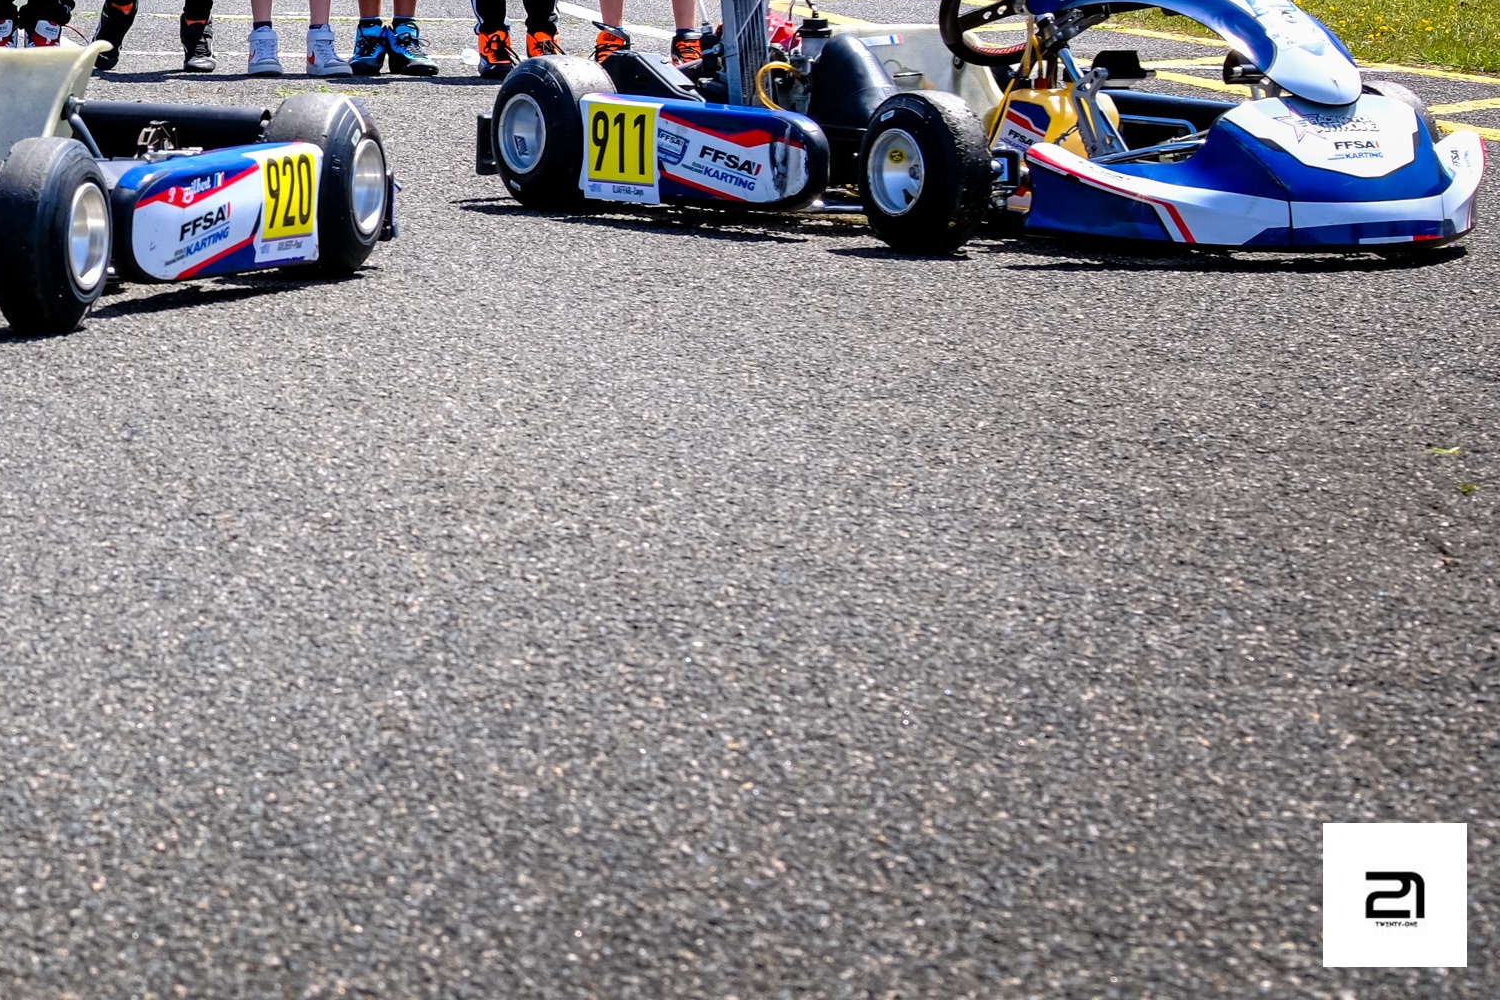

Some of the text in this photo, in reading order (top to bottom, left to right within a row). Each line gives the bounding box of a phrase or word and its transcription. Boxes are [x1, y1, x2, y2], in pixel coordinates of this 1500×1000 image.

[592, 110, 647, 176] 911
[1334, 141, 1375, 150] FFSA
[699, 144, 754, 176] FFSA
[266, 153, 312, 229] 920
[703, 166, 756, 191] KARTING
[179, 205, 226, 242] FFSA
[185, 226, 230, 258] KARTING
